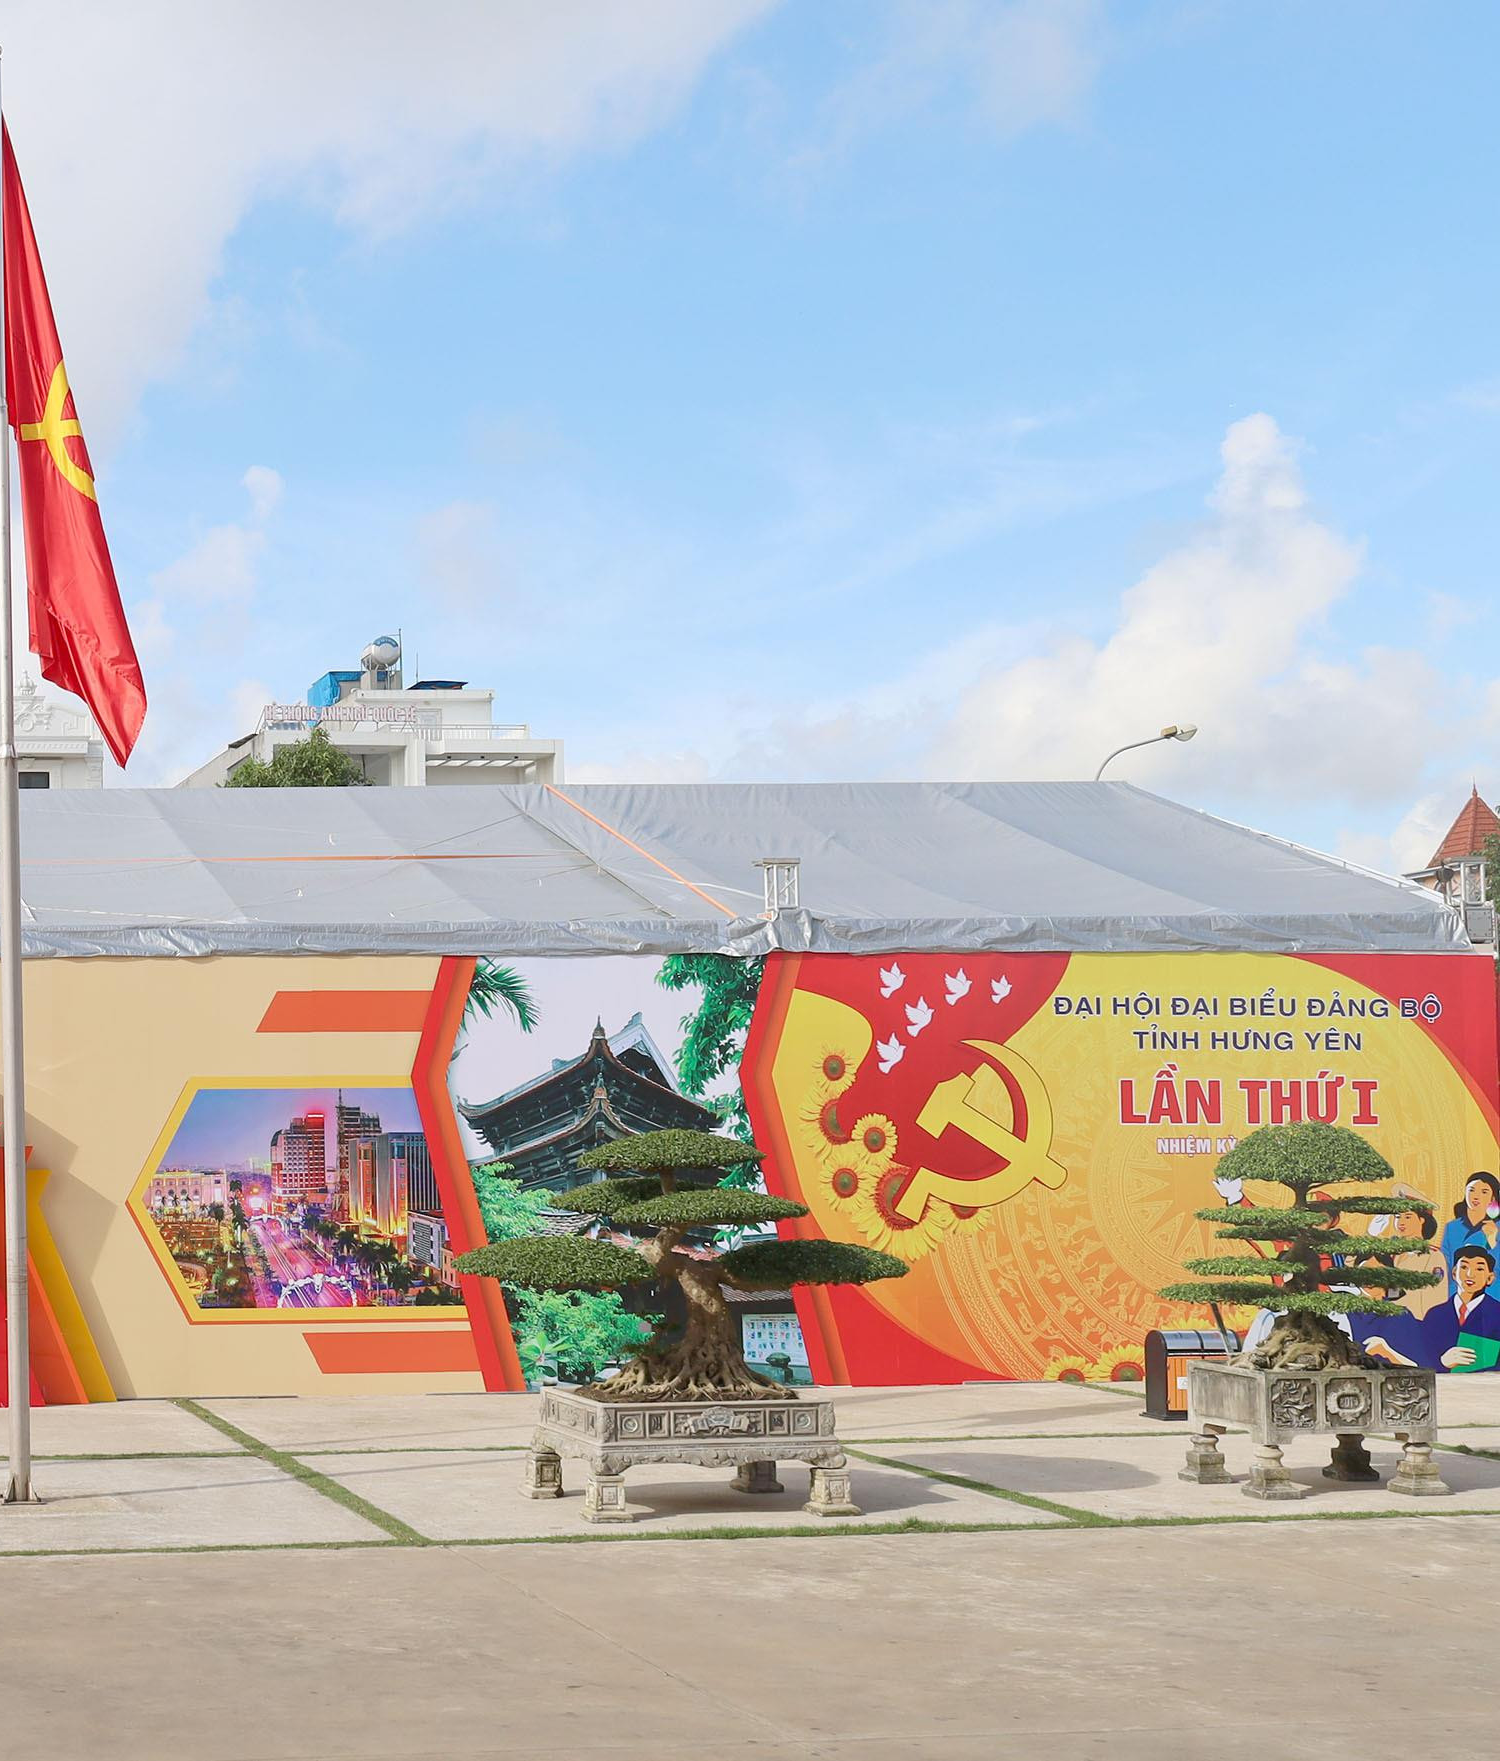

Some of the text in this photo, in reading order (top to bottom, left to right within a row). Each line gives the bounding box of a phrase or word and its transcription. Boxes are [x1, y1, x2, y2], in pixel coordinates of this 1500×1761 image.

[321, 706, 343, 721] ANH
[1053, 987, 1442, 1022] ĐẠI HỘI ĐẠI BIỂU ĐẢNG BỘ
[1133, 1024, 1362, 1051] TỈNH HƯNG YÊN
[1119, 1063, 1379, 1125] LẦN THỨ I
[1157, 1134, 1238, 1157] NHIỆM KỲ
